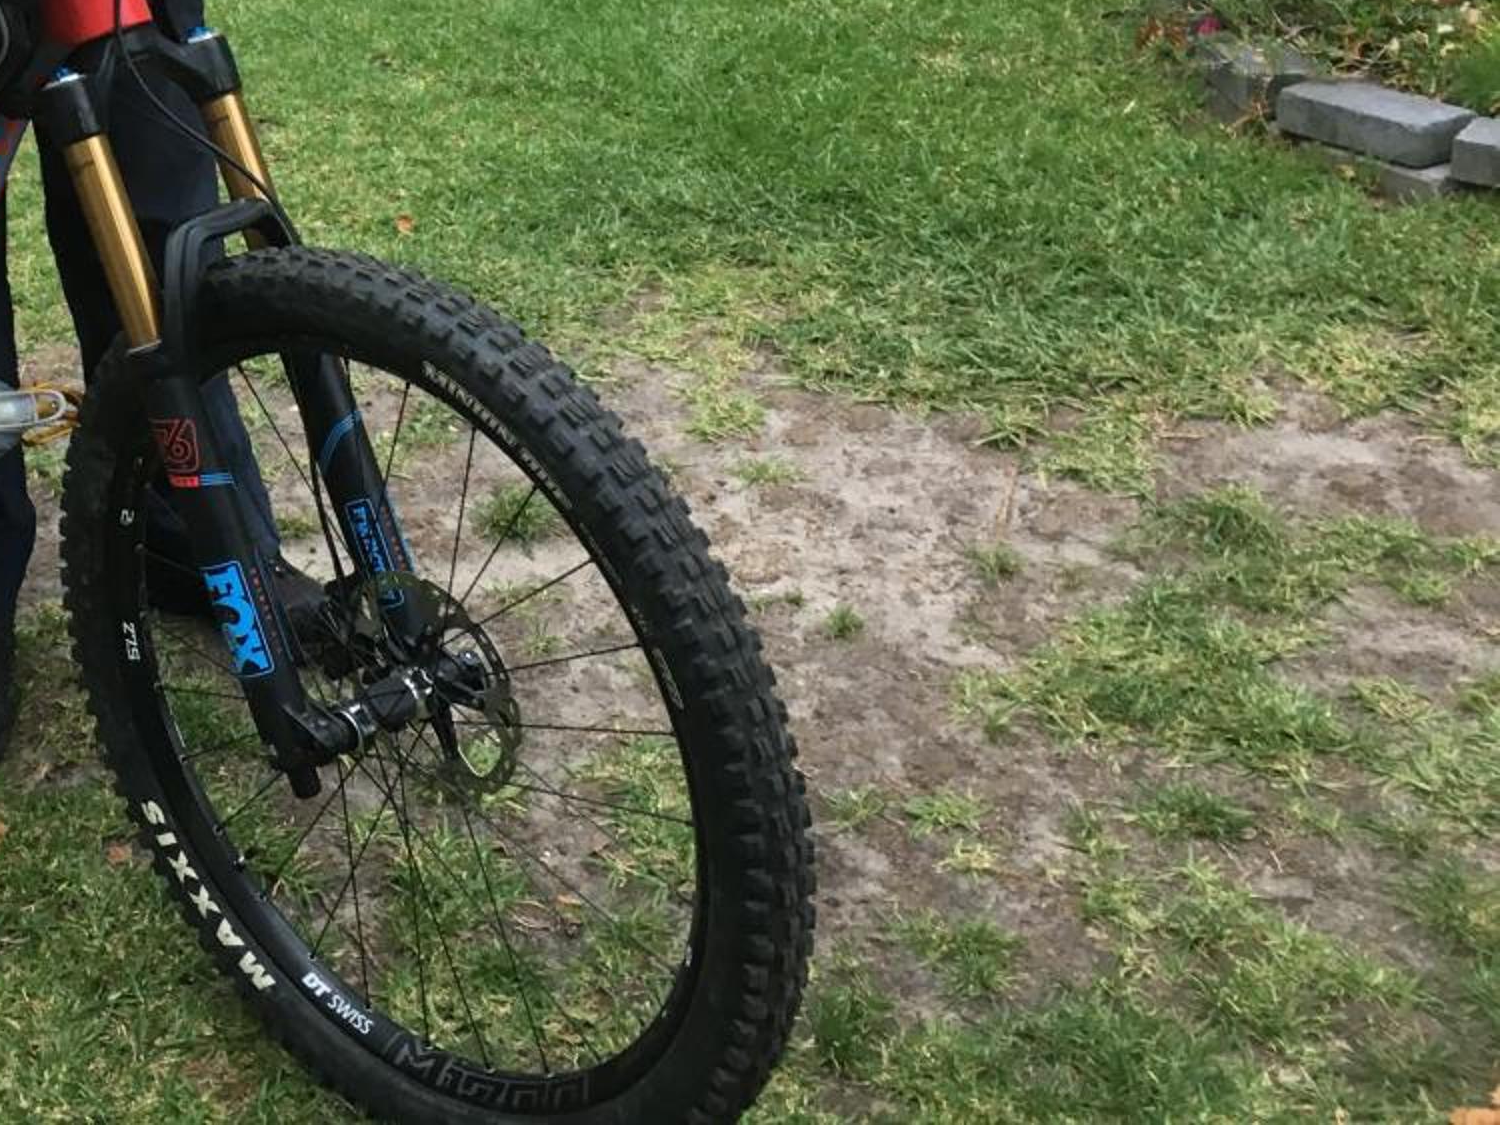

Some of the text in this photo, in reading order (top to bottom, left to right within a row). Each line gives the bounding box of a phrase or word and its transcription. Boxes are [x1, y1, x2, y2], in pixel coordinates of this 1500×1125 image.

[203, 564, 271, 676] FOX
[140, 799, 277, 992] MAXXIS
[301, 971, 375, 1035] DT SWISS
